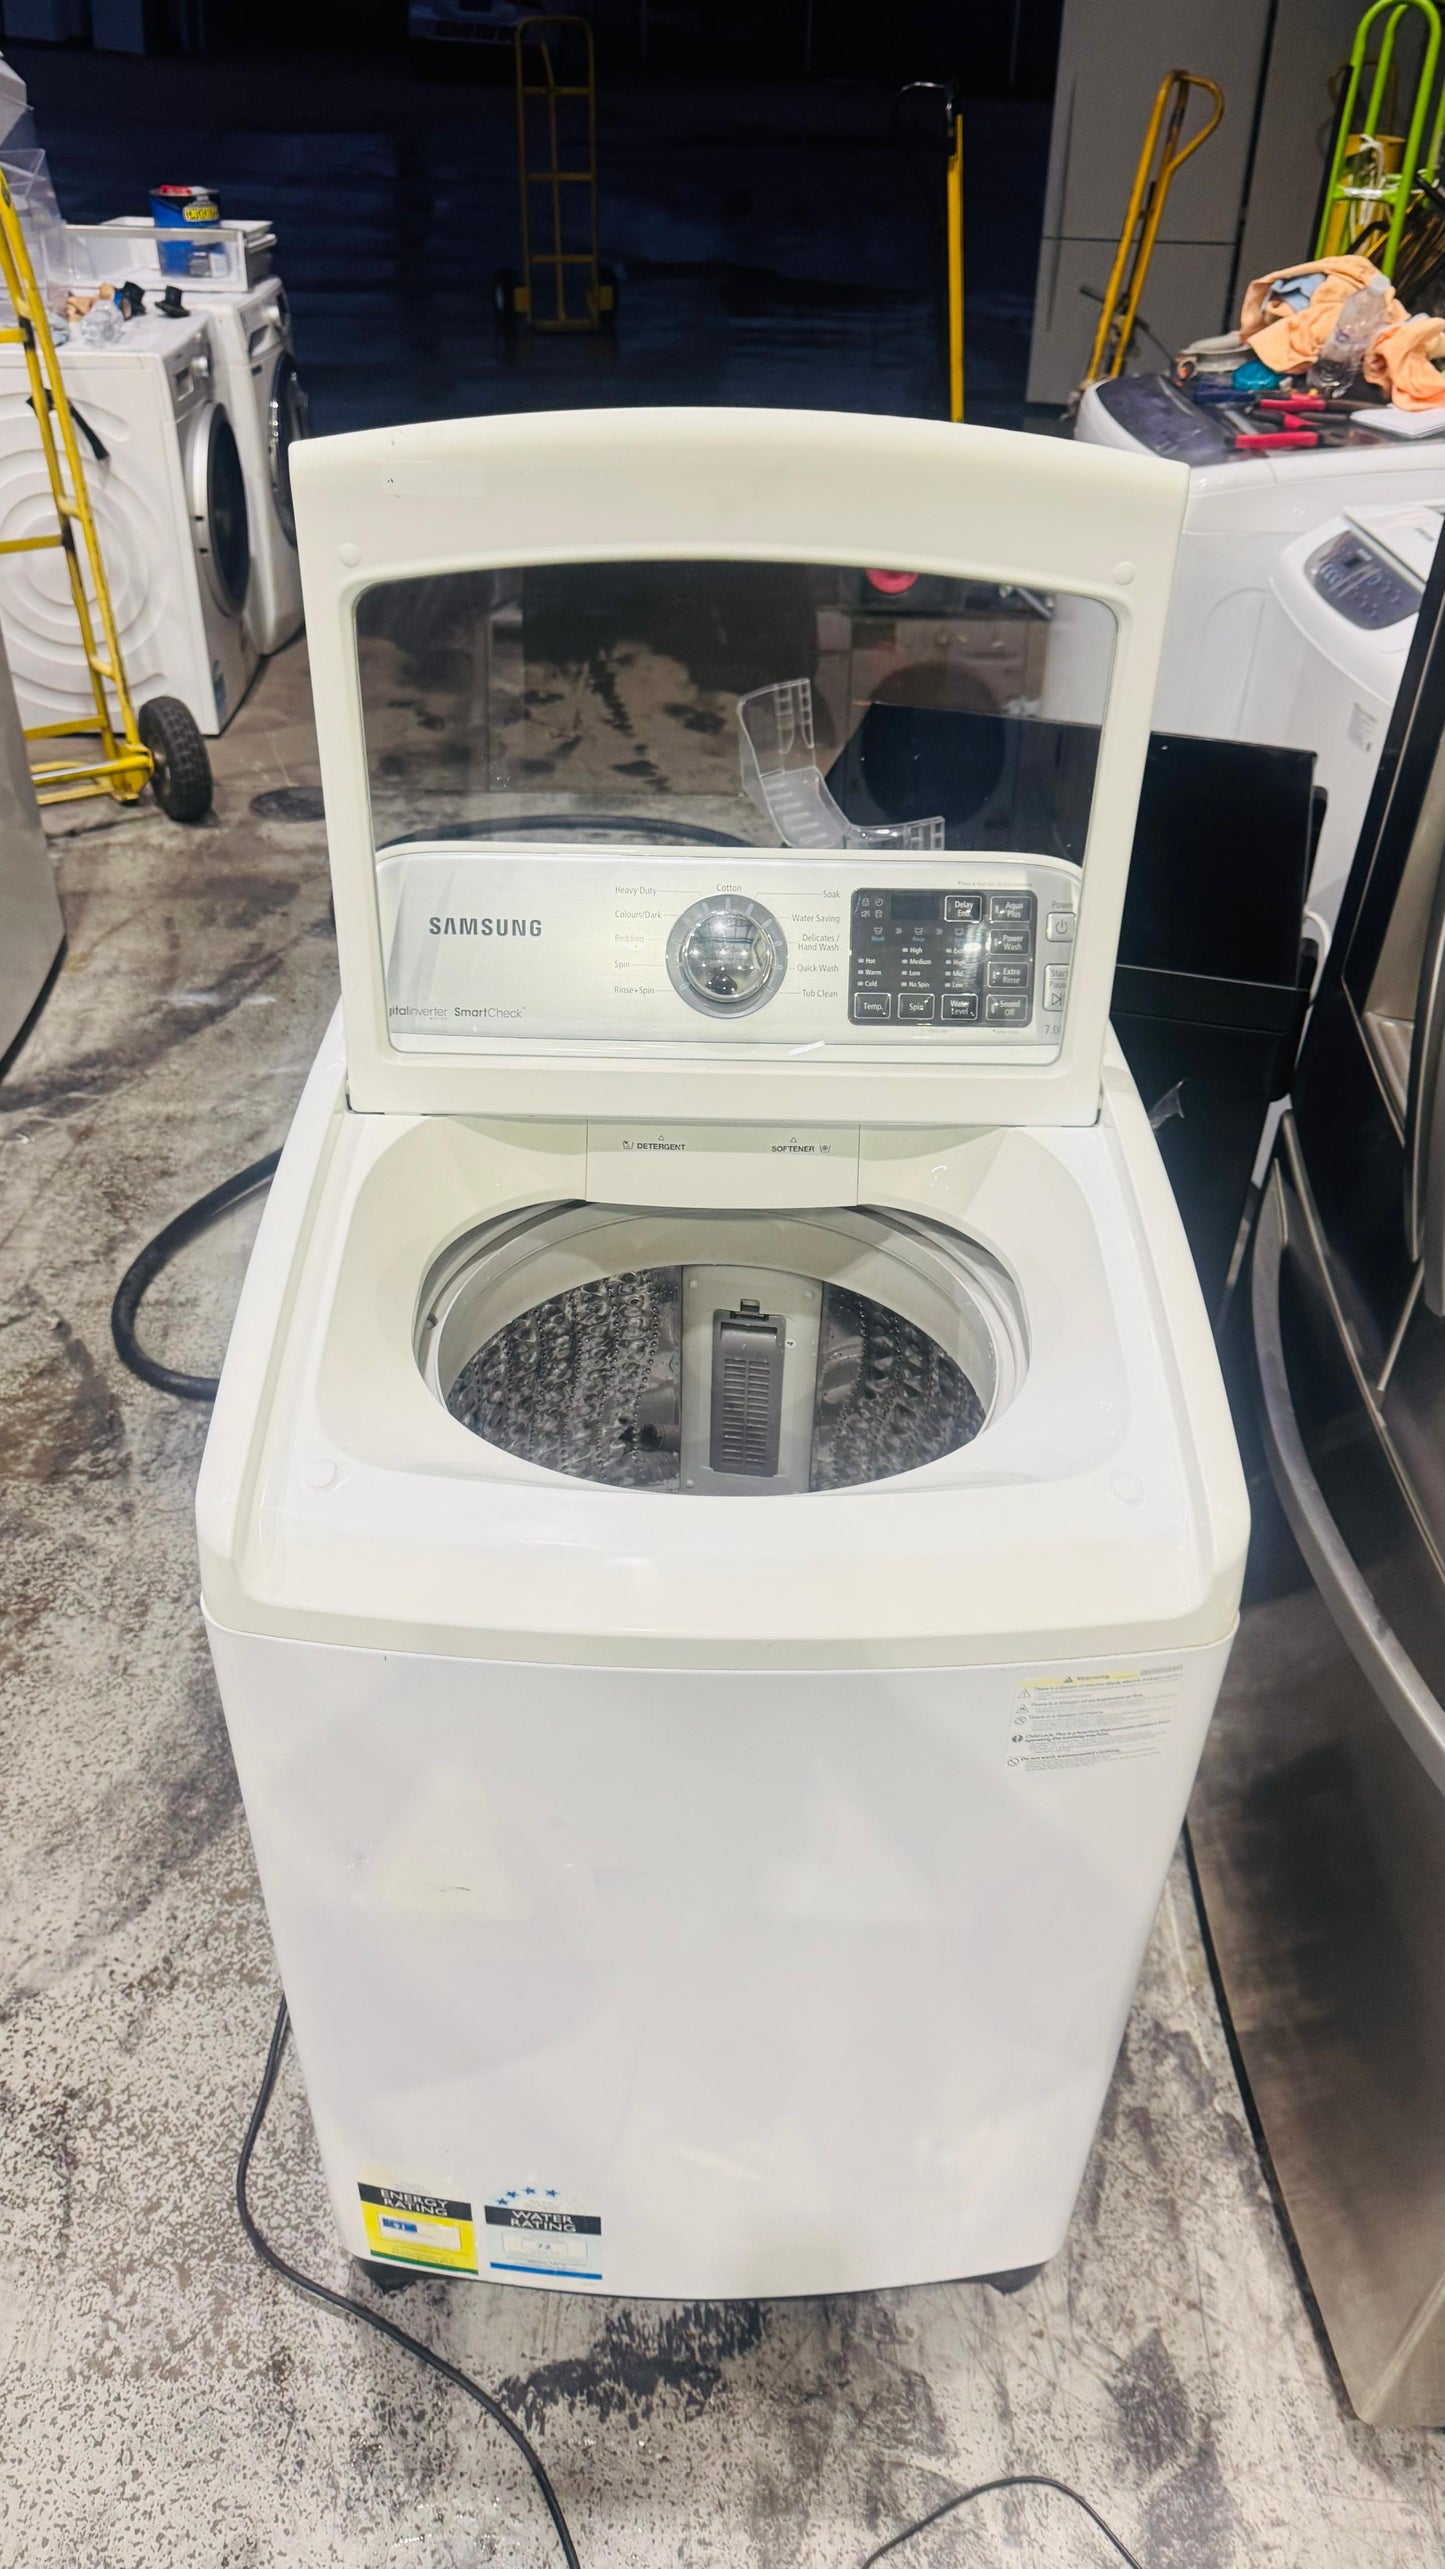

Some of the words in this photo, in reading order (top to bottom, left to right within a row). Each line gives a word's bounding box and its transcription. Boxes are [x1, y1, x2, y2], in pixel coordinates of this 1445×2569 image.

[615, 886, 638, 896] Heavy
[640, 887, 657, 896] Duty
[716, 884, 742, 892] Cotton
[823, 890, 840, 898] Soak
[954, 901, 974, 910] Delay
[792, 914, 814, 922] Water
[816, 914, 841, 924] Saving
[429, 916, 543, 937] SAMSUNG
[802, 934, 834, 942] Delicates
[1002, 934, 1024, 943] Power
[798, 943, 817, 951] Hand
[820, 943, 840, 951] Wash
[1003, 942, 1023, 951] Wash
[614, 960, 630, 969] Spin
[797, 964, 817, 972] Quick
[819, 964, 839, 972] Wash
[1002, 967, 1021, 975] Extra
[803, 989, 816, 997] Tub
[817, 989, 838, 998] Clean
[863, 1002, 884, 1012] Temp.
[950, 1000, 970, 1008] Water
[951, 1007, 969, 1016] Level
[636, 1142, 686, 1151] DETERGENT
[771, 1145, 815, 1153] SOFTENER
[380, 2188, 448, 2209] ENERGY
[384, 2197, 448, 2217] RATING
[511, 2210, 573, 2225] WATER
[510, 2218, 577, 2233] RATING
